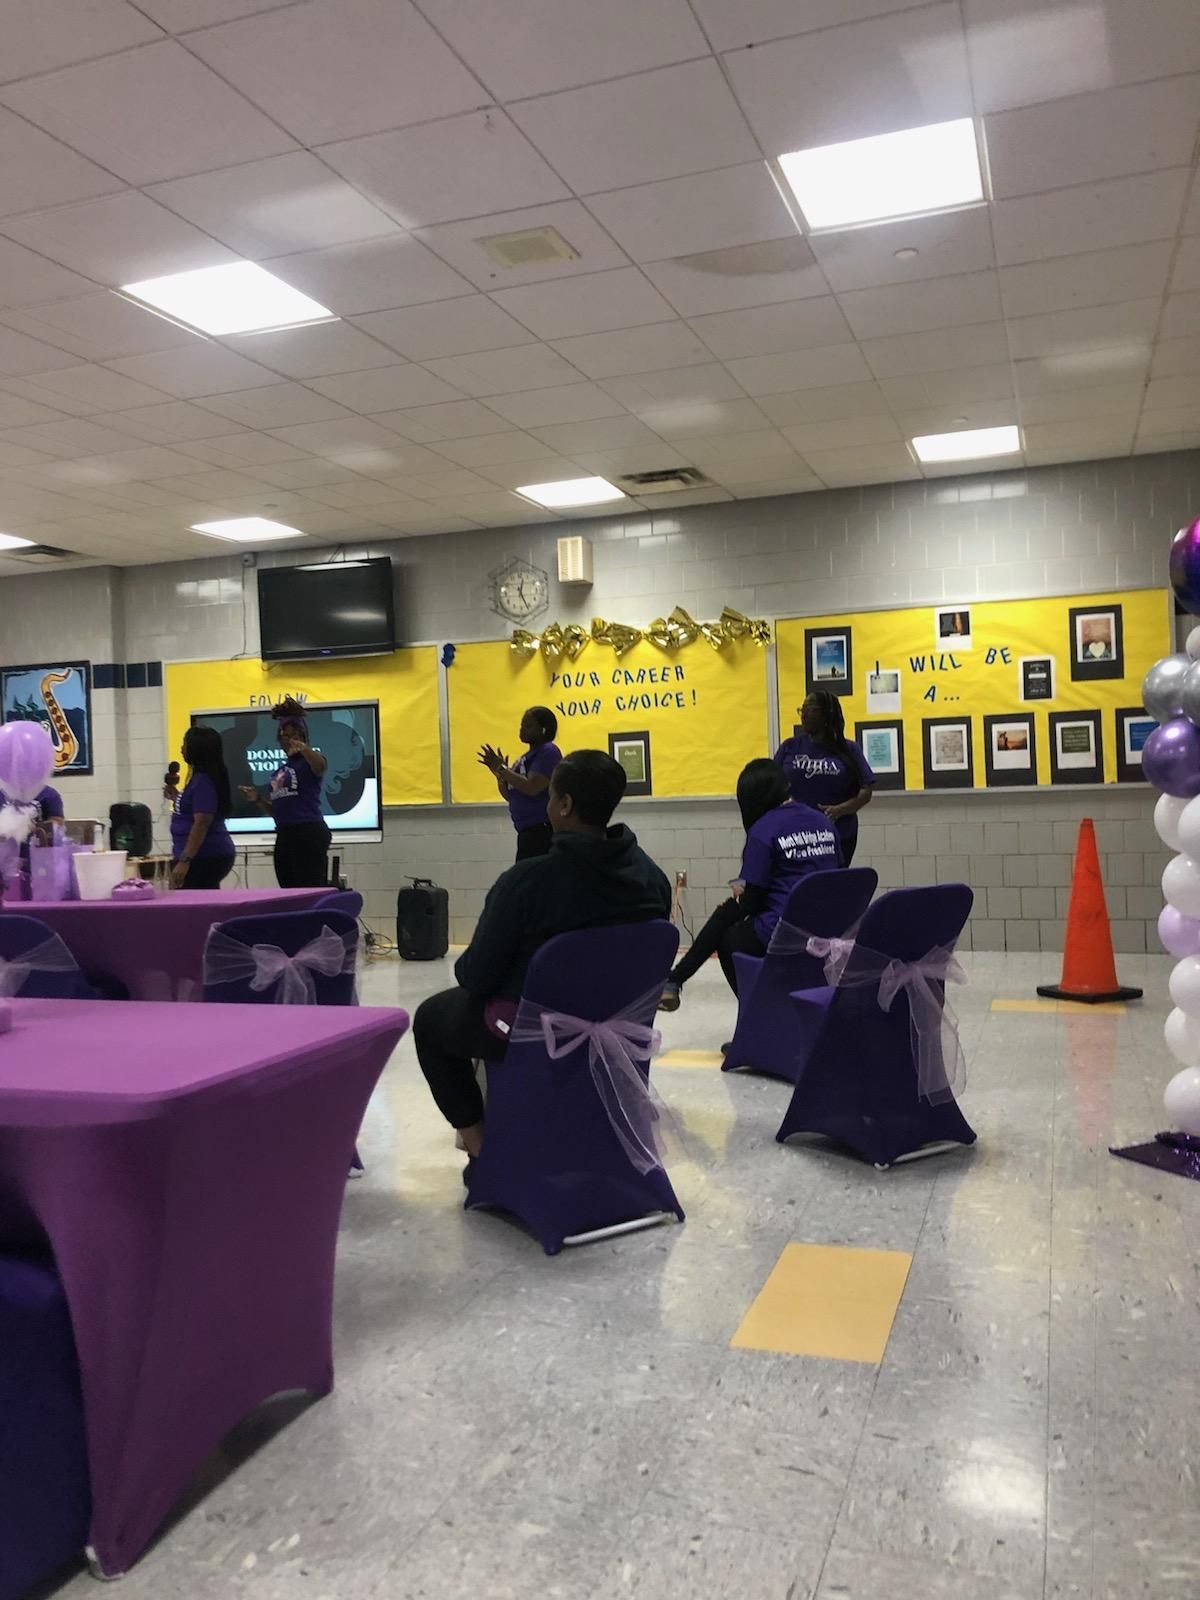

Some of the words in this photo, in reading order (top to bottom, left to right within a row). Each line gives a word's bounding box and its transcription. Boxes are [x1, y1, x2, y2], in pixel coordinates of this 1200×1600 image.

[910, 654, 962, 673] WILL
[985, 647, 1012, 665] BE
[550, 671, 600, 689] YOUR
[612, 665, 684, 685] CAREER
[556, 699, 601, 717] YOUR
[615, 689, 696, 711] CHOICE!
